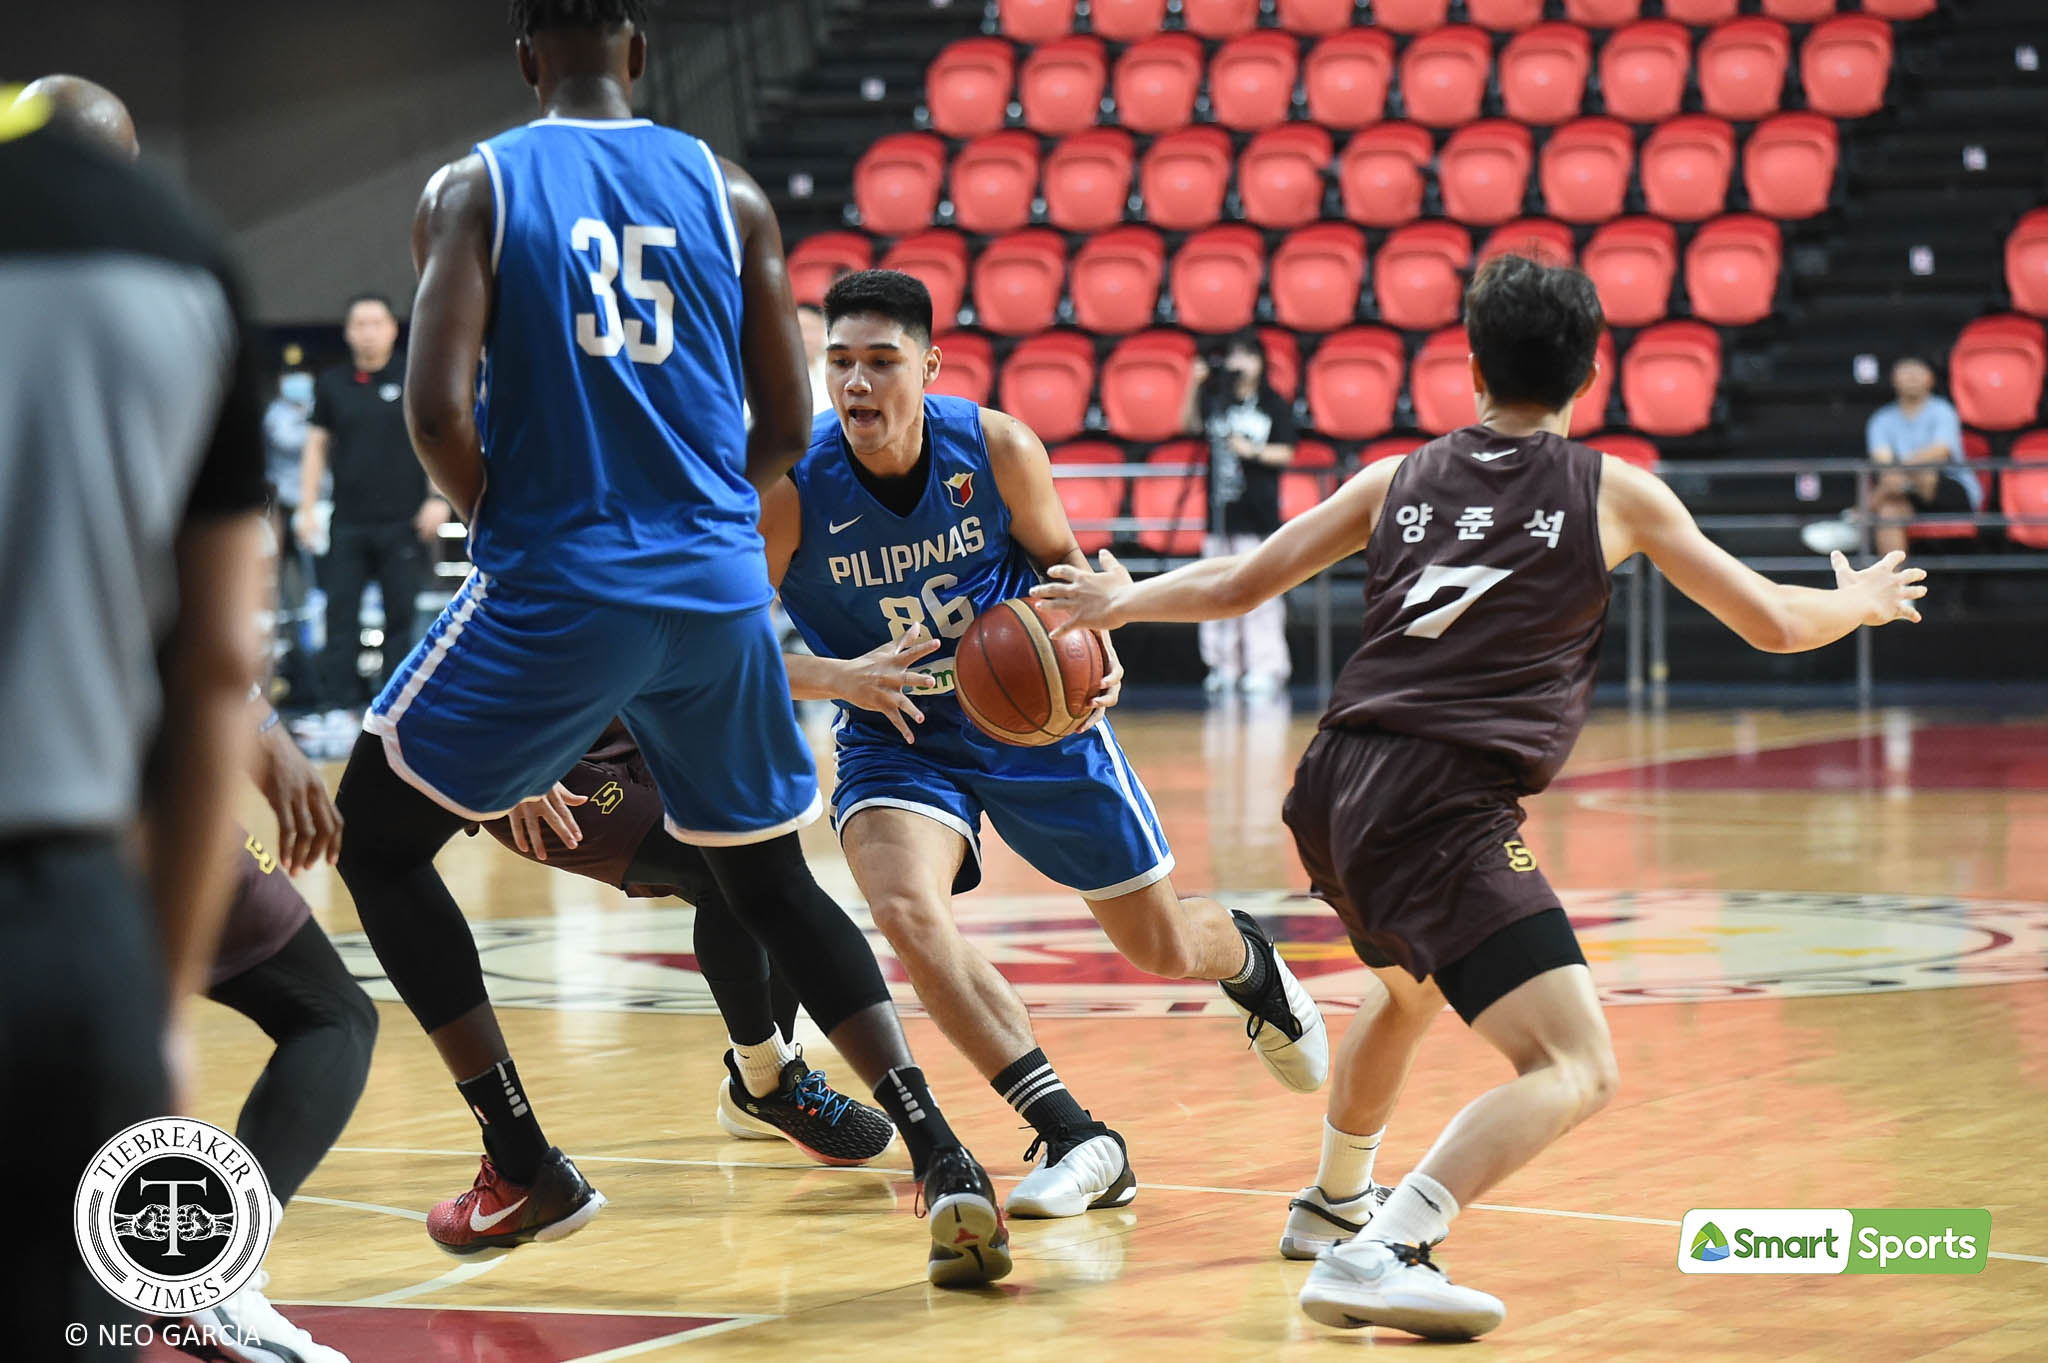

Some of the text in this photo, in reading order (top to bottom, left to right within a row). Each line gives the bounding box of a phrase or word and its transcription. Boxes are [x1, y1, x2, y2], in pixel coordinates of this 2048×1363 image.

[571, 217, 677, 365] 35
[828, 515, 985, 588] PILIPINAS
[879, 573, 975, 648] 86
[1402, 565, 1514, 639] 7
